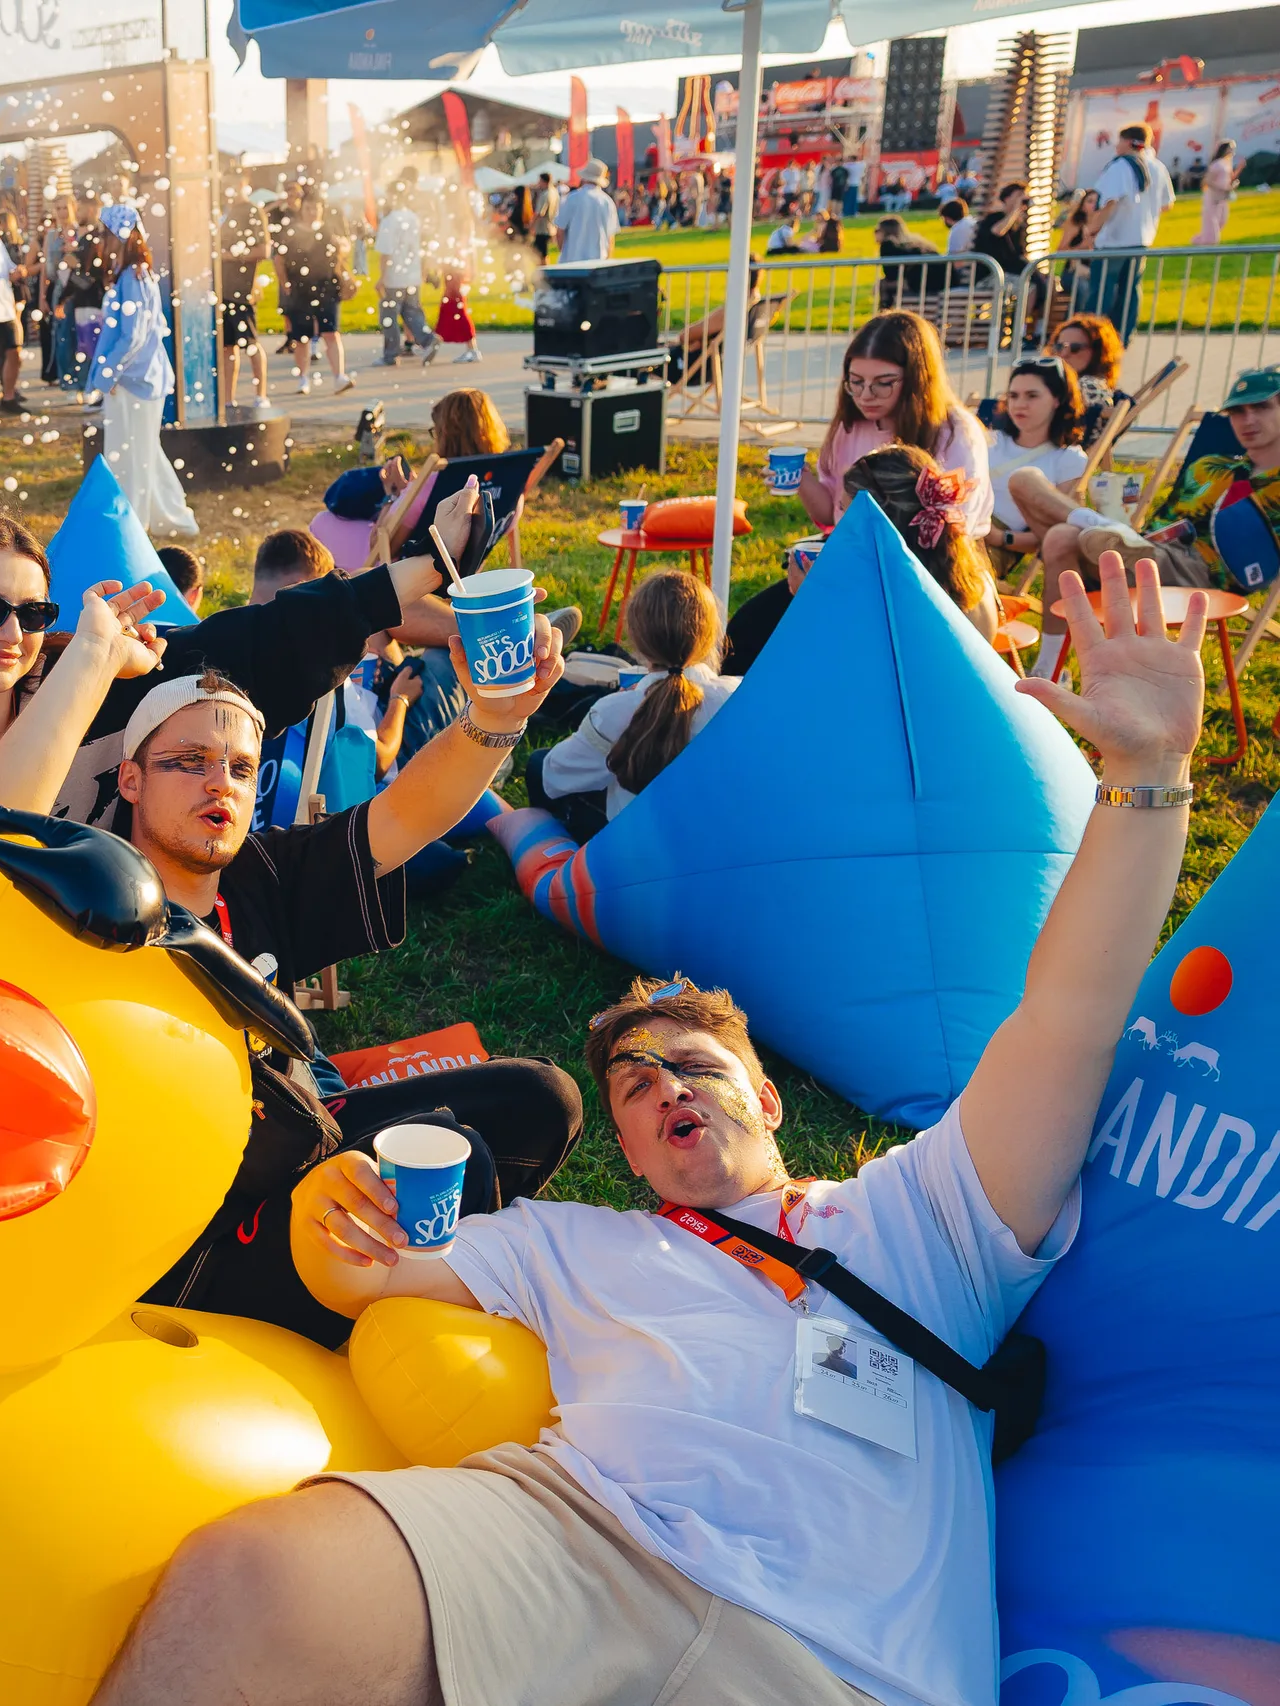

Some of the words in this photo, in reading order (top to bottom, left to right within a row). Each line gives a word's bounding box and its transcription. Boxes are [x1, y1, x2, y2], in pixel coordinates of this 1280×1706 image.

[480, 635, 514, 658] IT'S
[349, 1053, 483, 1090] INLANDIA
[431, 1189, 461, 1216] IT'S
[679, 1212, 709, 1234] eska2
[731, 1244, 766, 1265] eska
